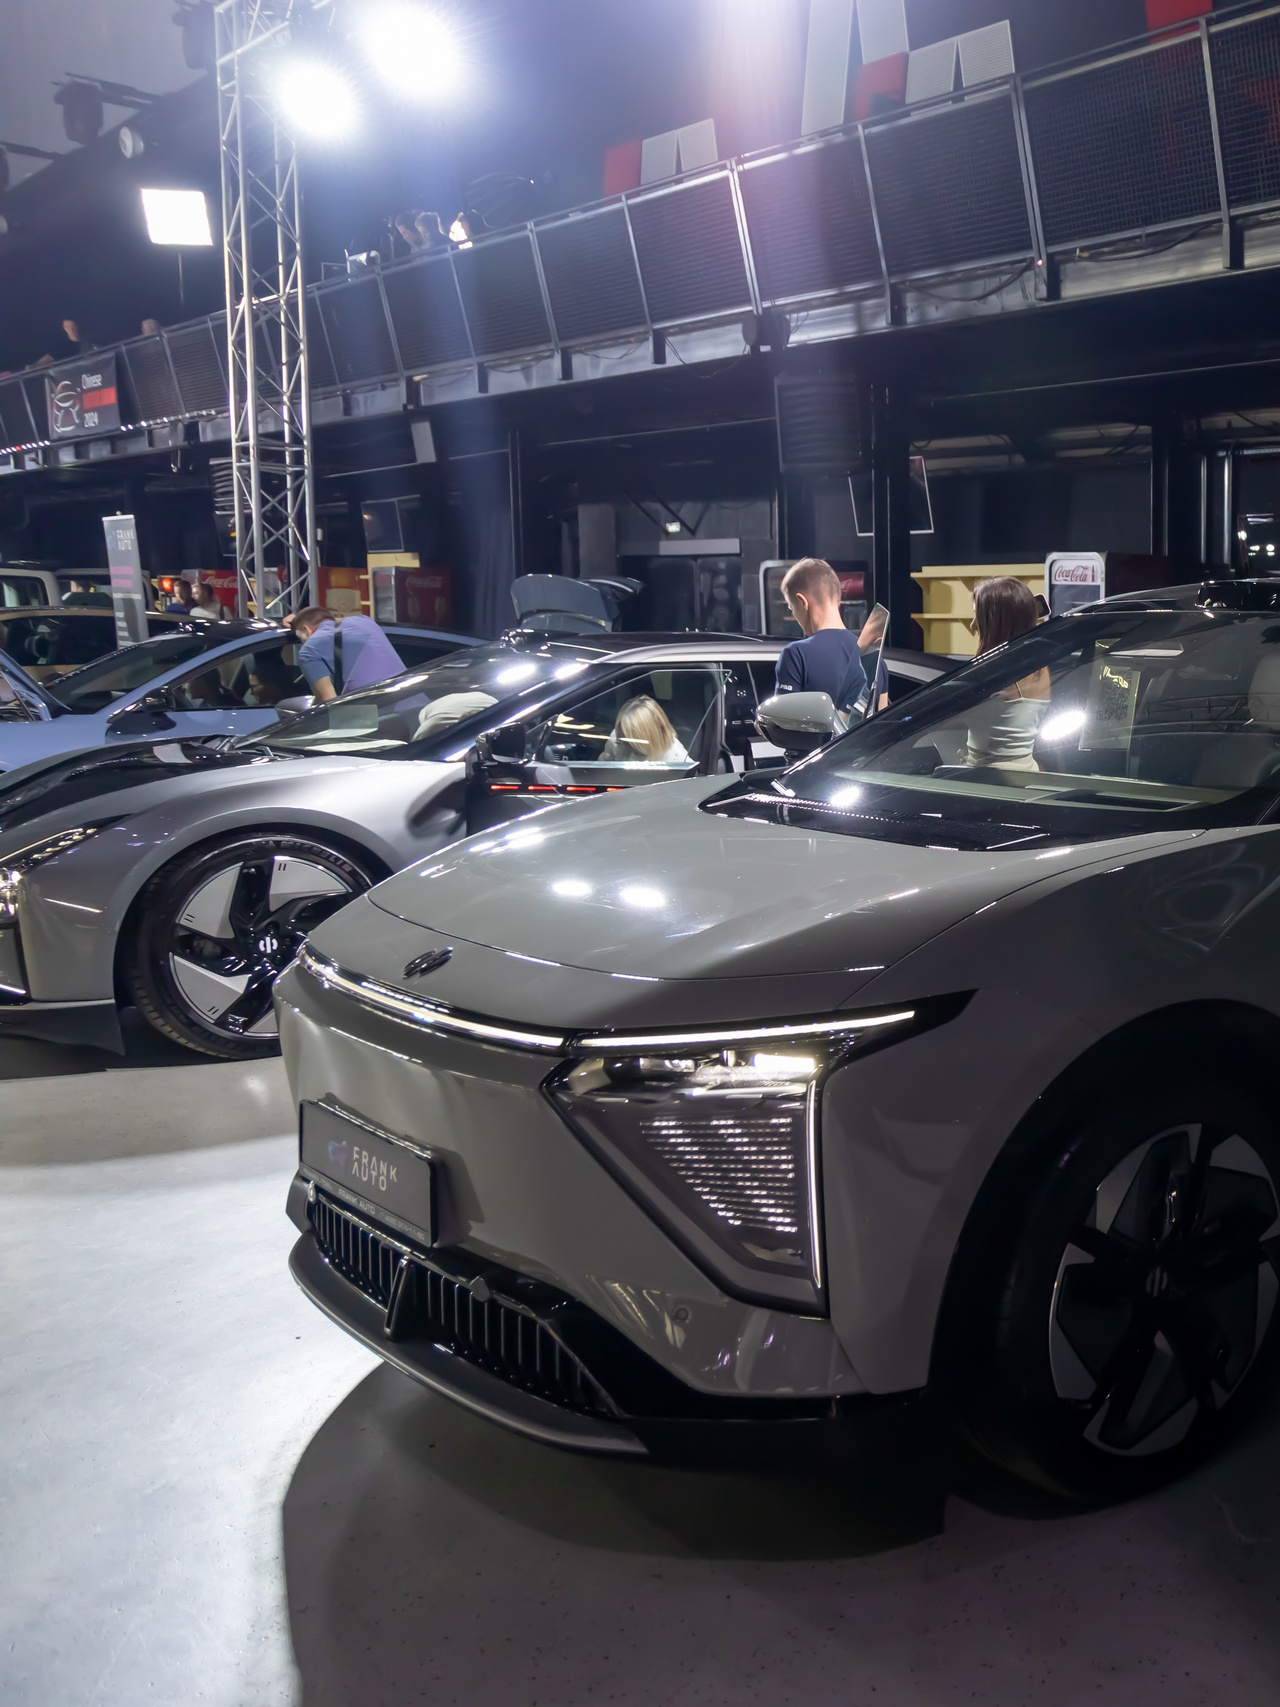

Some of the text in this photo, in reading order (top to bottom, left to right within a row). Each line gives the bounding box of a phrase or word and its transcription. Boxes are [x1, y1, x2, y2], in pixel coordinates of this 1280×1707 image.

[84, 411, 99, 427] 2024
[281, 840, 353, 873] MICHELIN
[352, 1162, 387, 1191] AUTO
[353, 1146, 398, 1183] FRANK
[338, 1188, 376, 1215] FRANK AUTO
